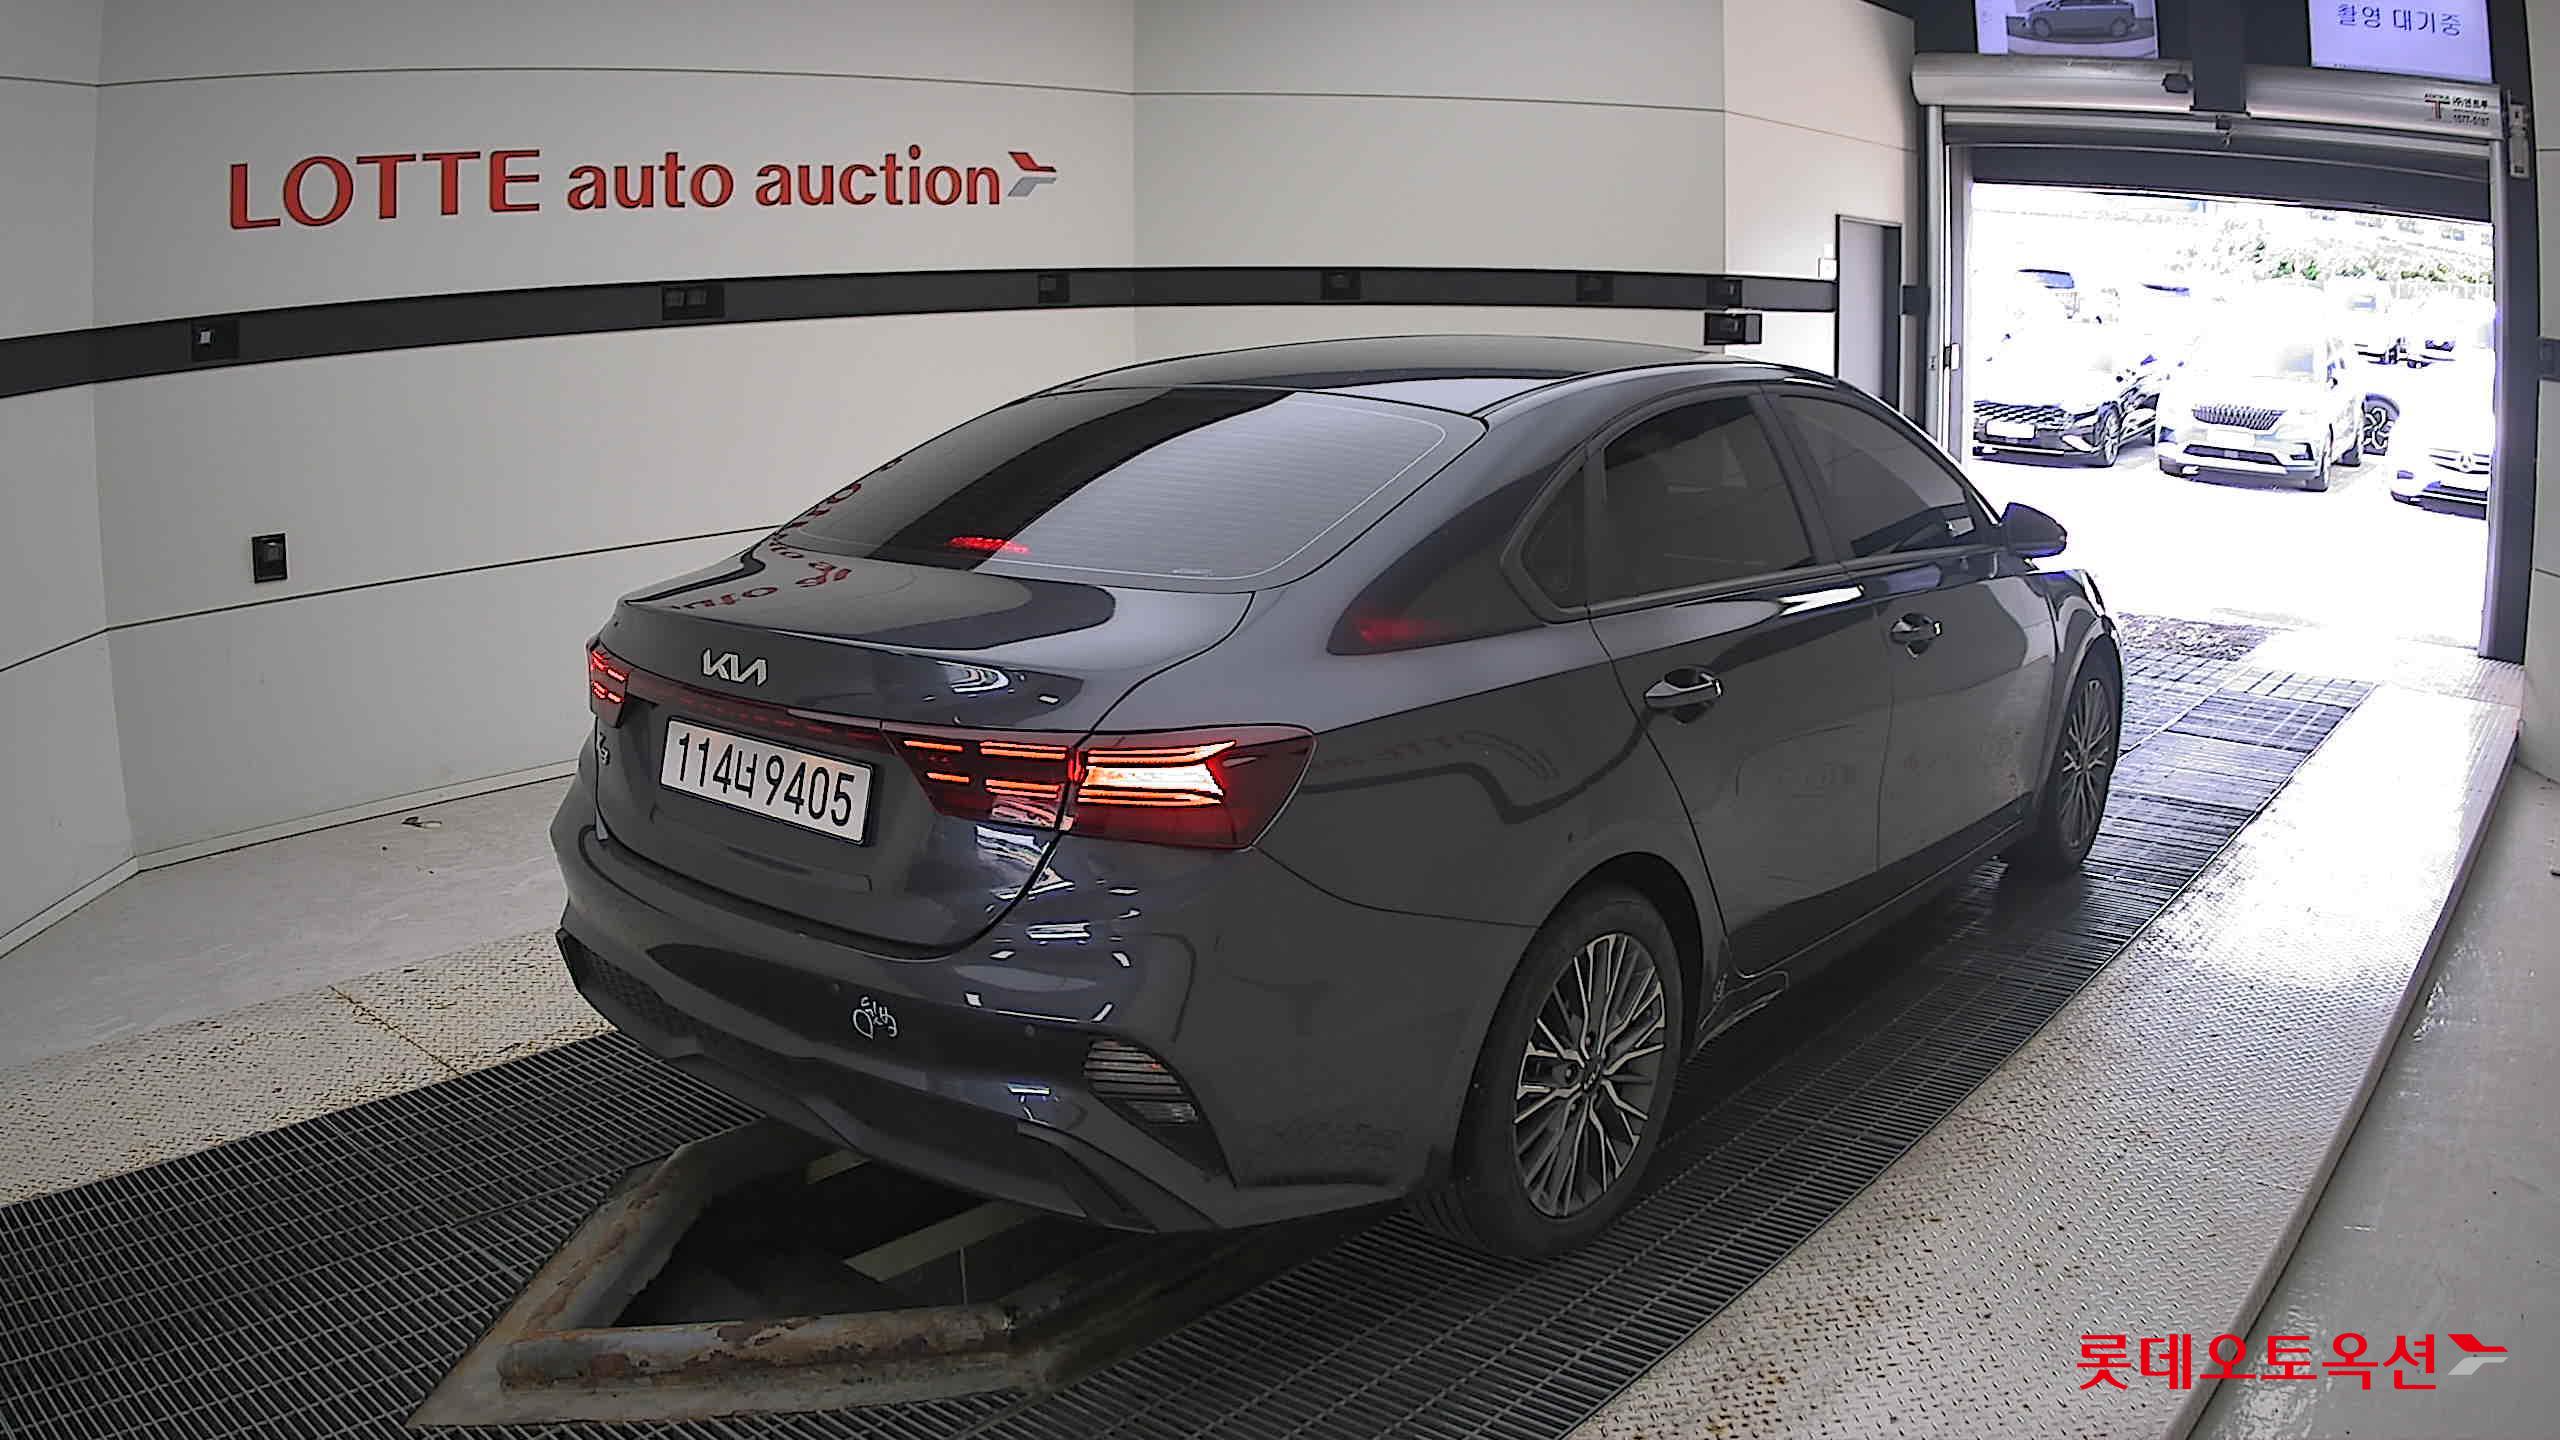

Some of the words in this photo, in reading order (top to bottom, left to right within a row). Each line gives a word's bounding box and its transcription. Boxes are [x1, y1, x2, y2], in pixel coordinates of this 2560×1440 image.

[2338, 4, 2381, 29] 촬영
[2392, 9, 2462, 36] 대기중
[229, 149, 542, 231] LOTTE
[567, 151, 734, 210] auto
[754, 144, 1002, 207] auction
